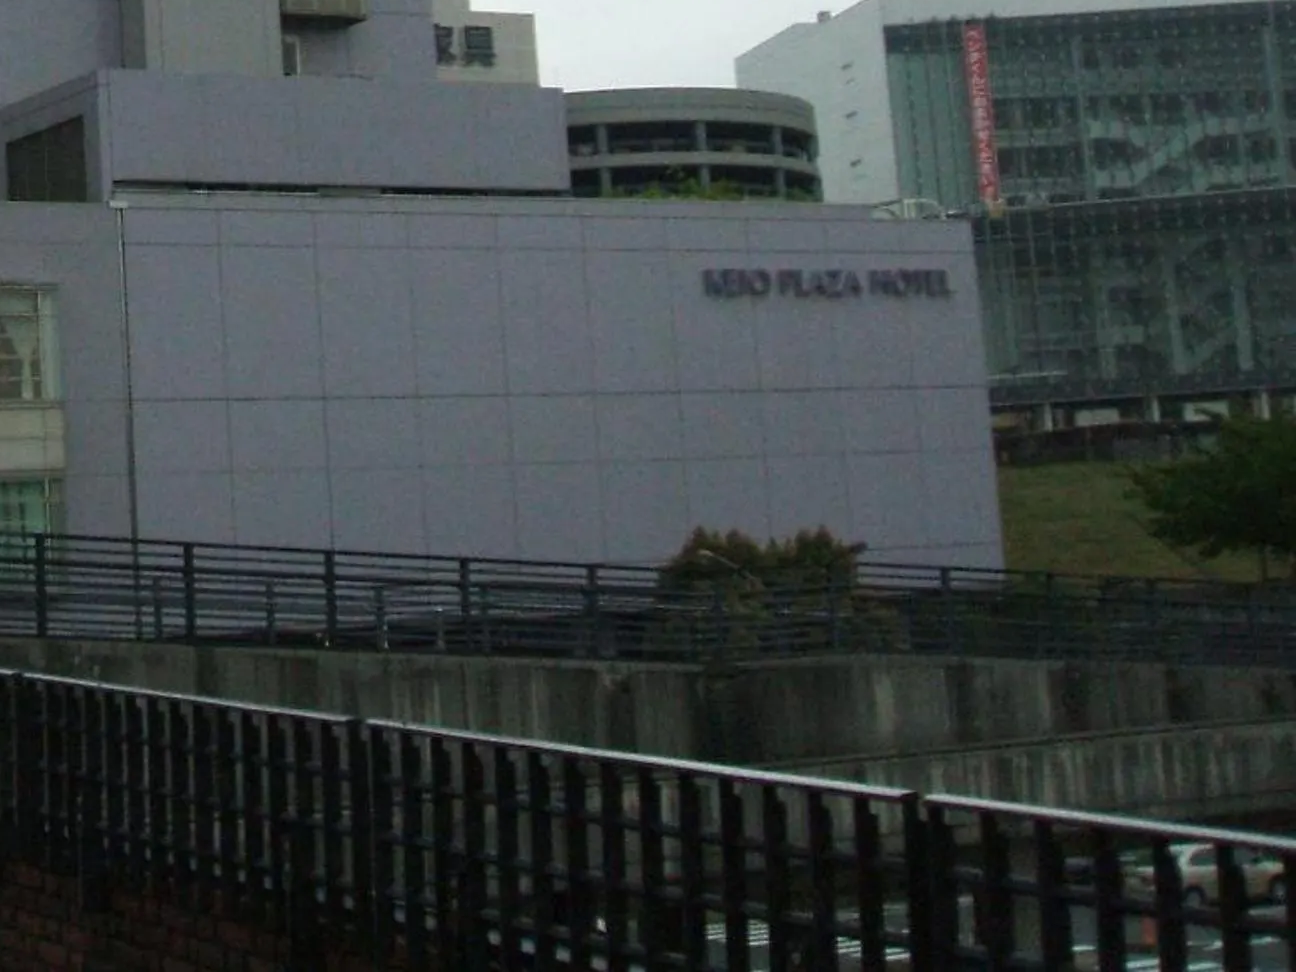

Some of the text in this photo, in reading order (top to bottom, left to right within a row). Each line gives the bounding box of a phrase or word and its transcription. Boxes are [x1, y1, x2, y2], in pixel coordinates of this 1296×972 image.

[702, 268, 954, 299] KEIO PLAZA HOTEL
